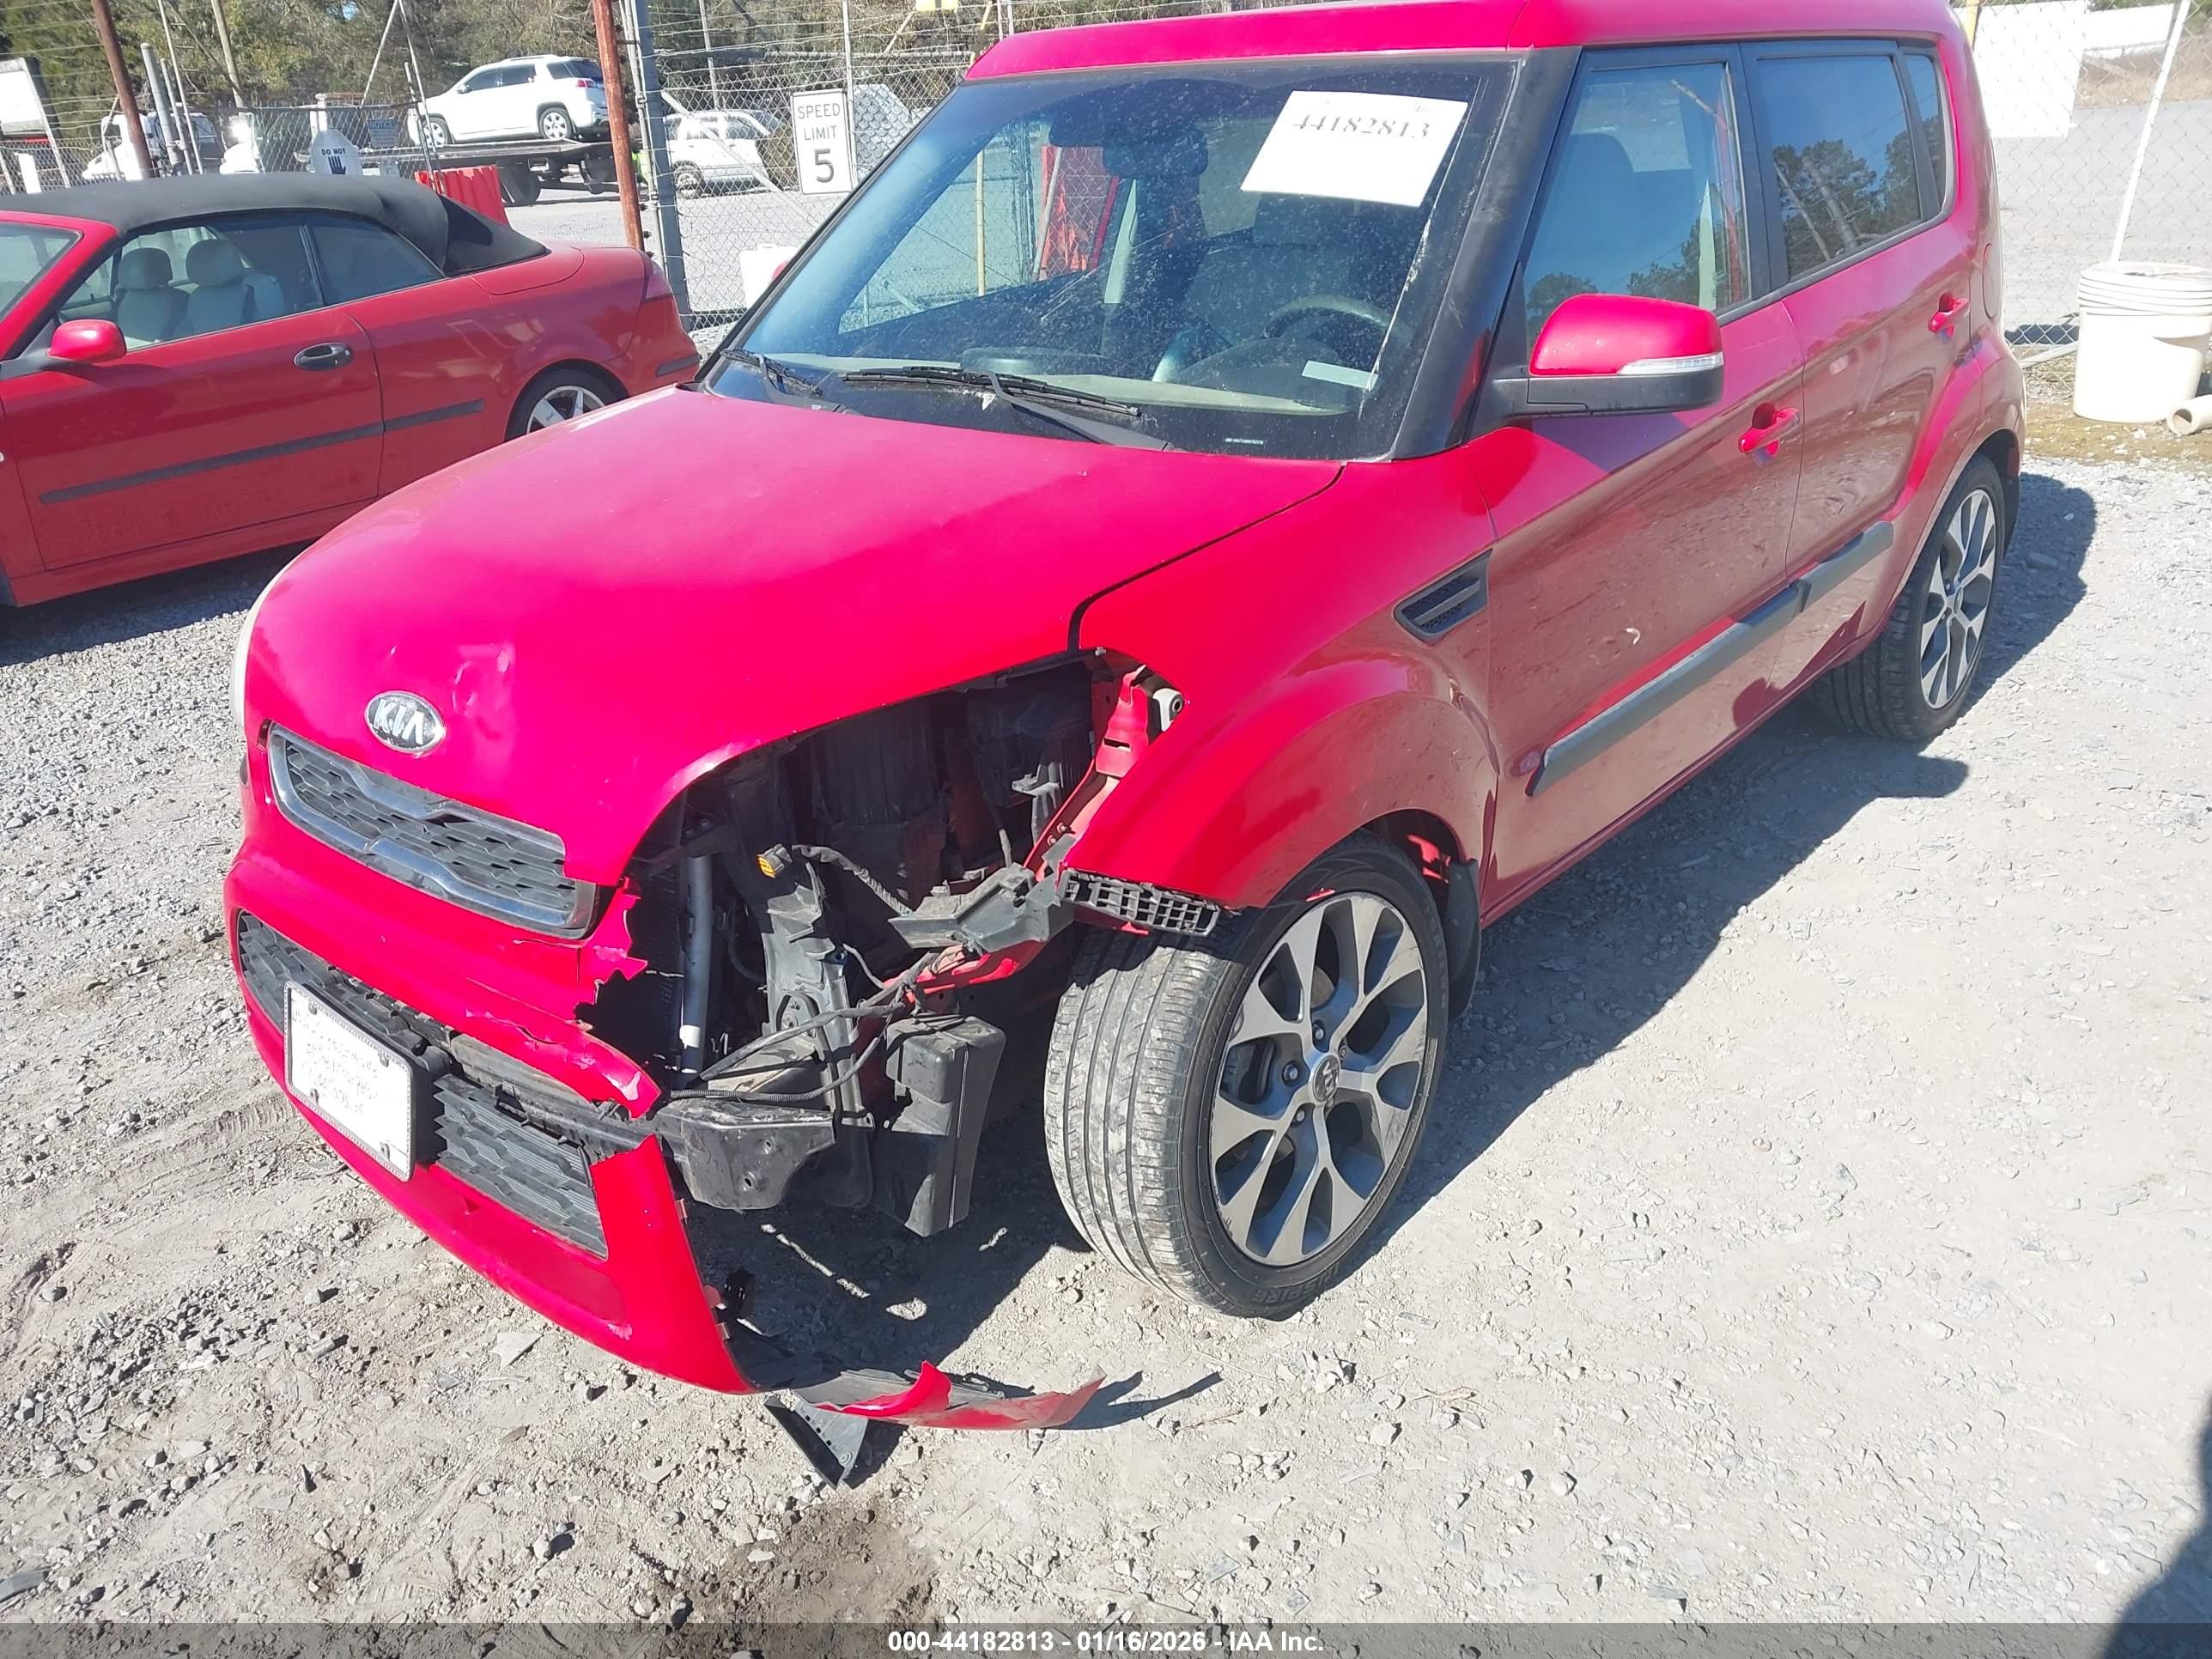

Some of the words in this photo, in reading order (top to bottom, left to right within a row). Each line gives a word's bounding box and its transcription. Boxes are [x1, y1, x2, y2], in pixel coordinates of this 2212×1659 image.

[797, 102, 841, 119] SPEED
[803, 125, 837, 141] LIMIT
[1293, 114, 1431, 138] 44182813
[814, 148, 835, 183] 5
[373, 698, 425, 745] KIA
